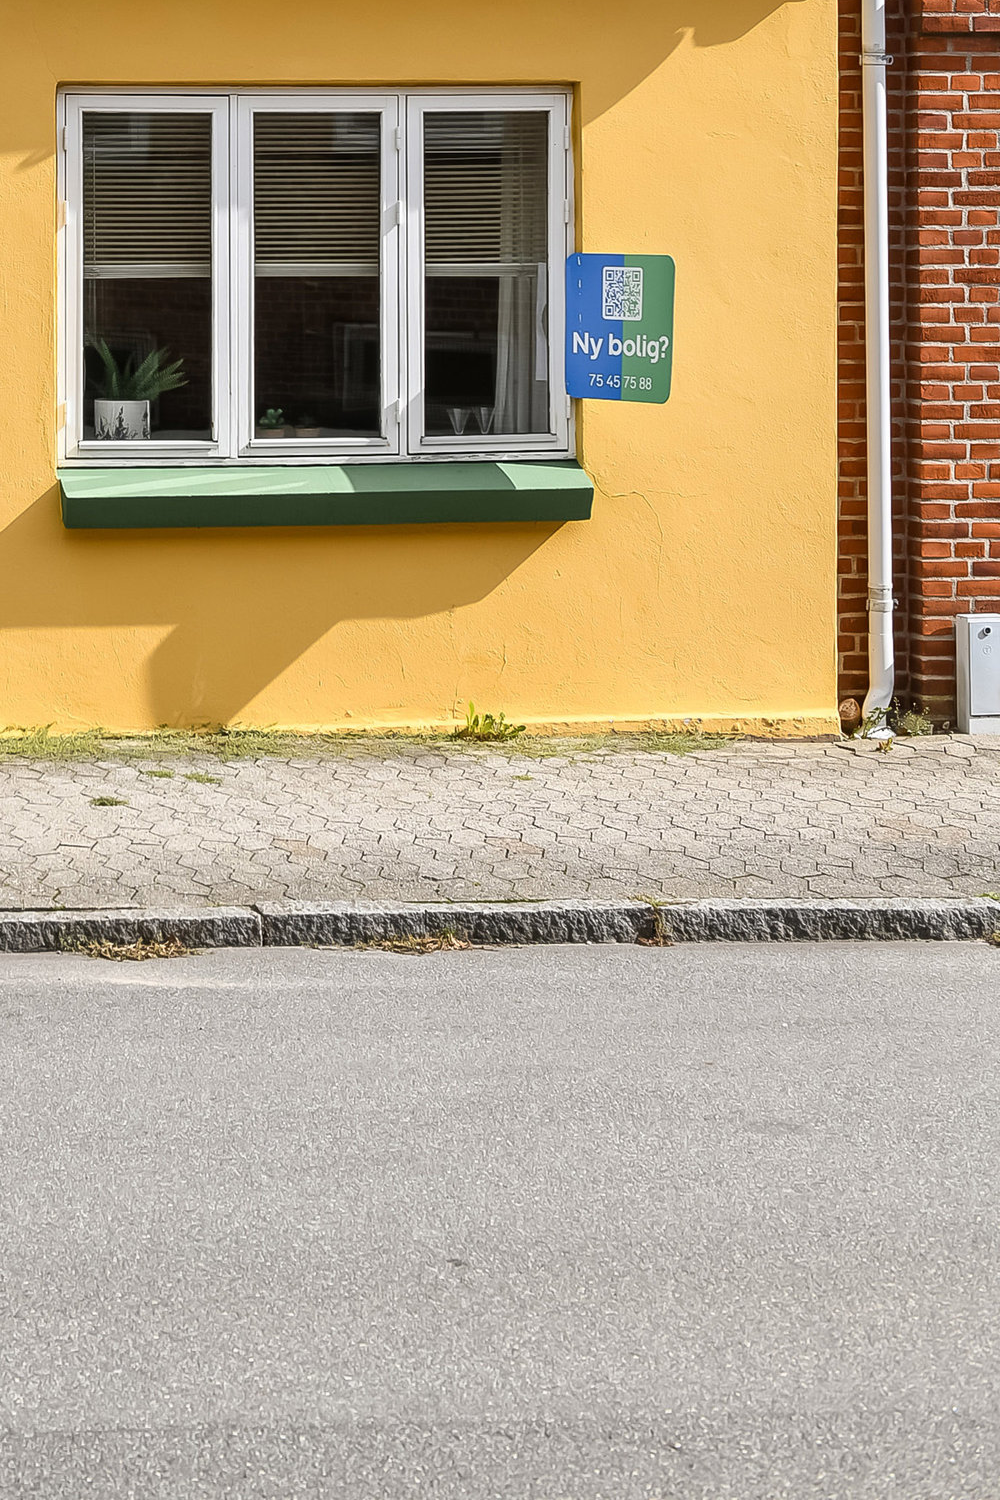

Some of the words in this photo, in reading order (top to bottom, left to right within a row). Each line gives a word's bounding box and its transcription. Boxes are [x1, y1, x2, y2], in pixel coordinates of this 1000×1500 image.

[572, 331, 604, 360] Ny
[608, 333, 670, 364] bolig?
[588, 373, 604, 388] 75
[606, 374, 621, 388] 45
[623, 375, 637, 389] 75
[638, 377, 652, 390] 88
